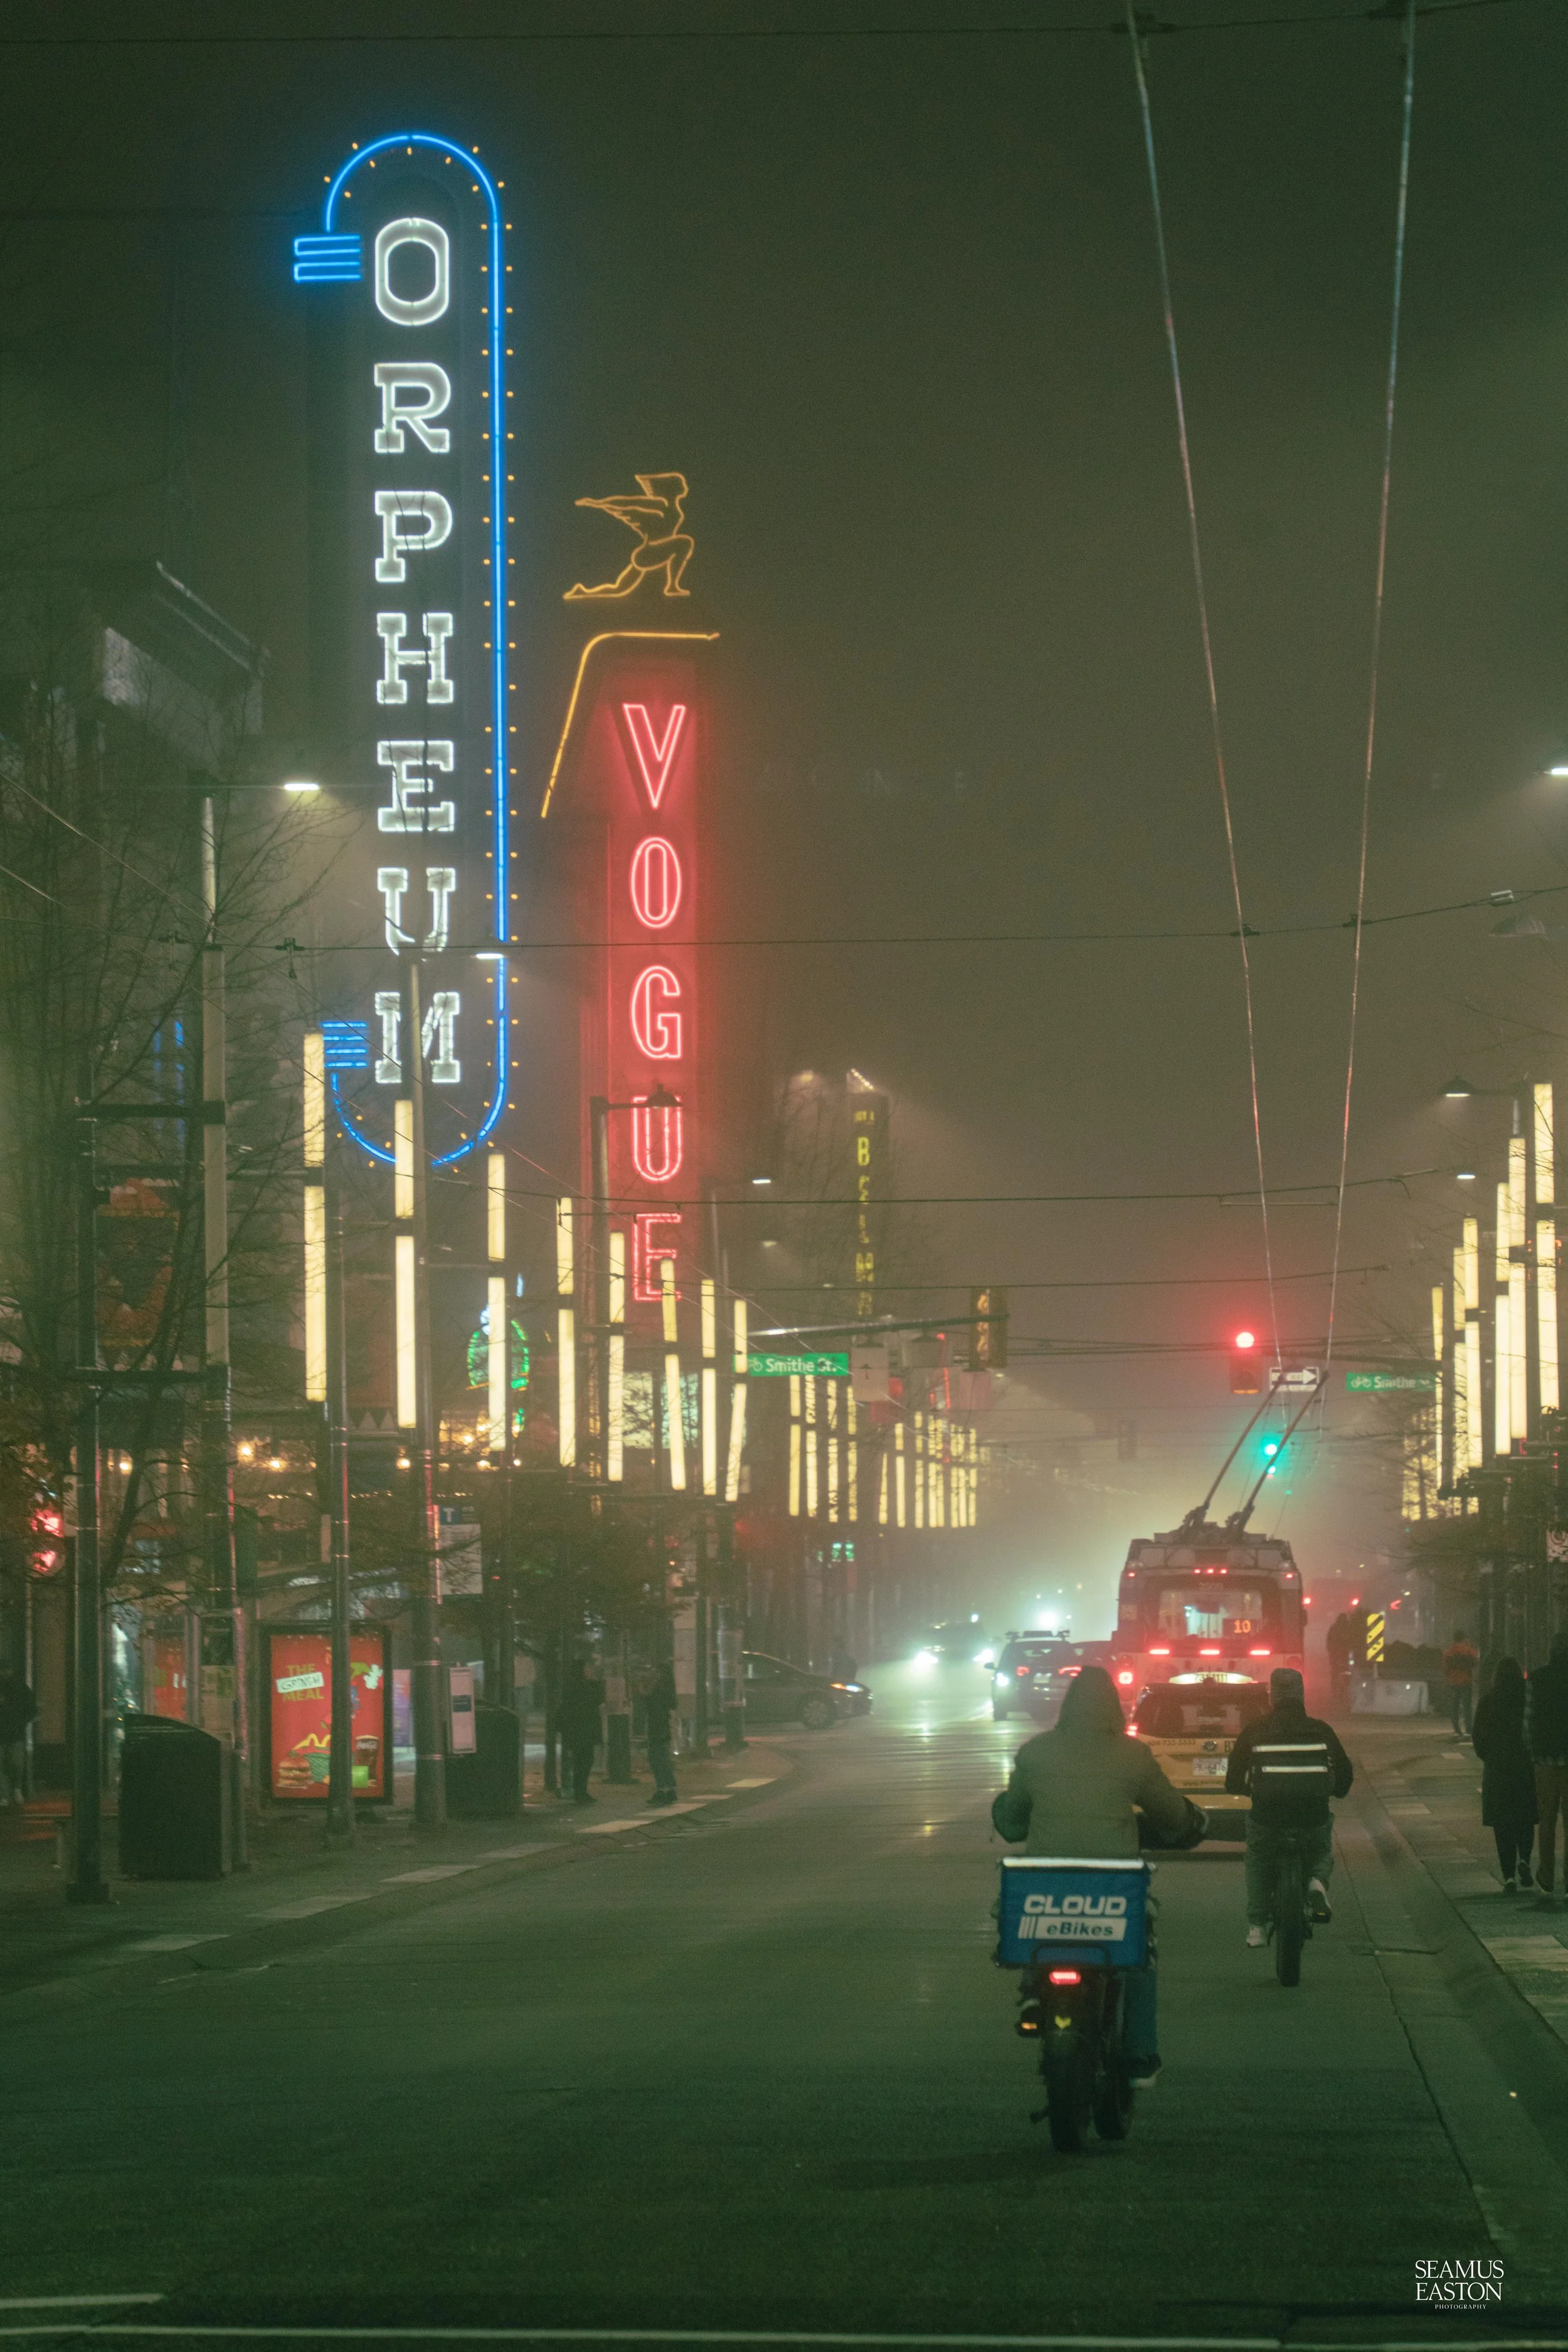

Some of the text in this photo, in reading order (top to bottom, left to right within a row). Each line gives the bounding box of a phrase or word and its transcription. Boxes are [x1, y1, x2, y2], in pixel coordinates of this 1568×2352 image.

[374, 216, 461, 1084] ORPHEUM
[623, 703, 686, 1303] VOGUE
[765, 1357, 815, 1372] Smithe
[1234, 1619, 1251, 1633] 10
[286, 1663, 316, 1677] THE
[282, 1687, 325, 1702] MEAL
[1023, 1894, 1127, 1916] CLOUD
[1046, 1921, 1114, 1937] eBikes
